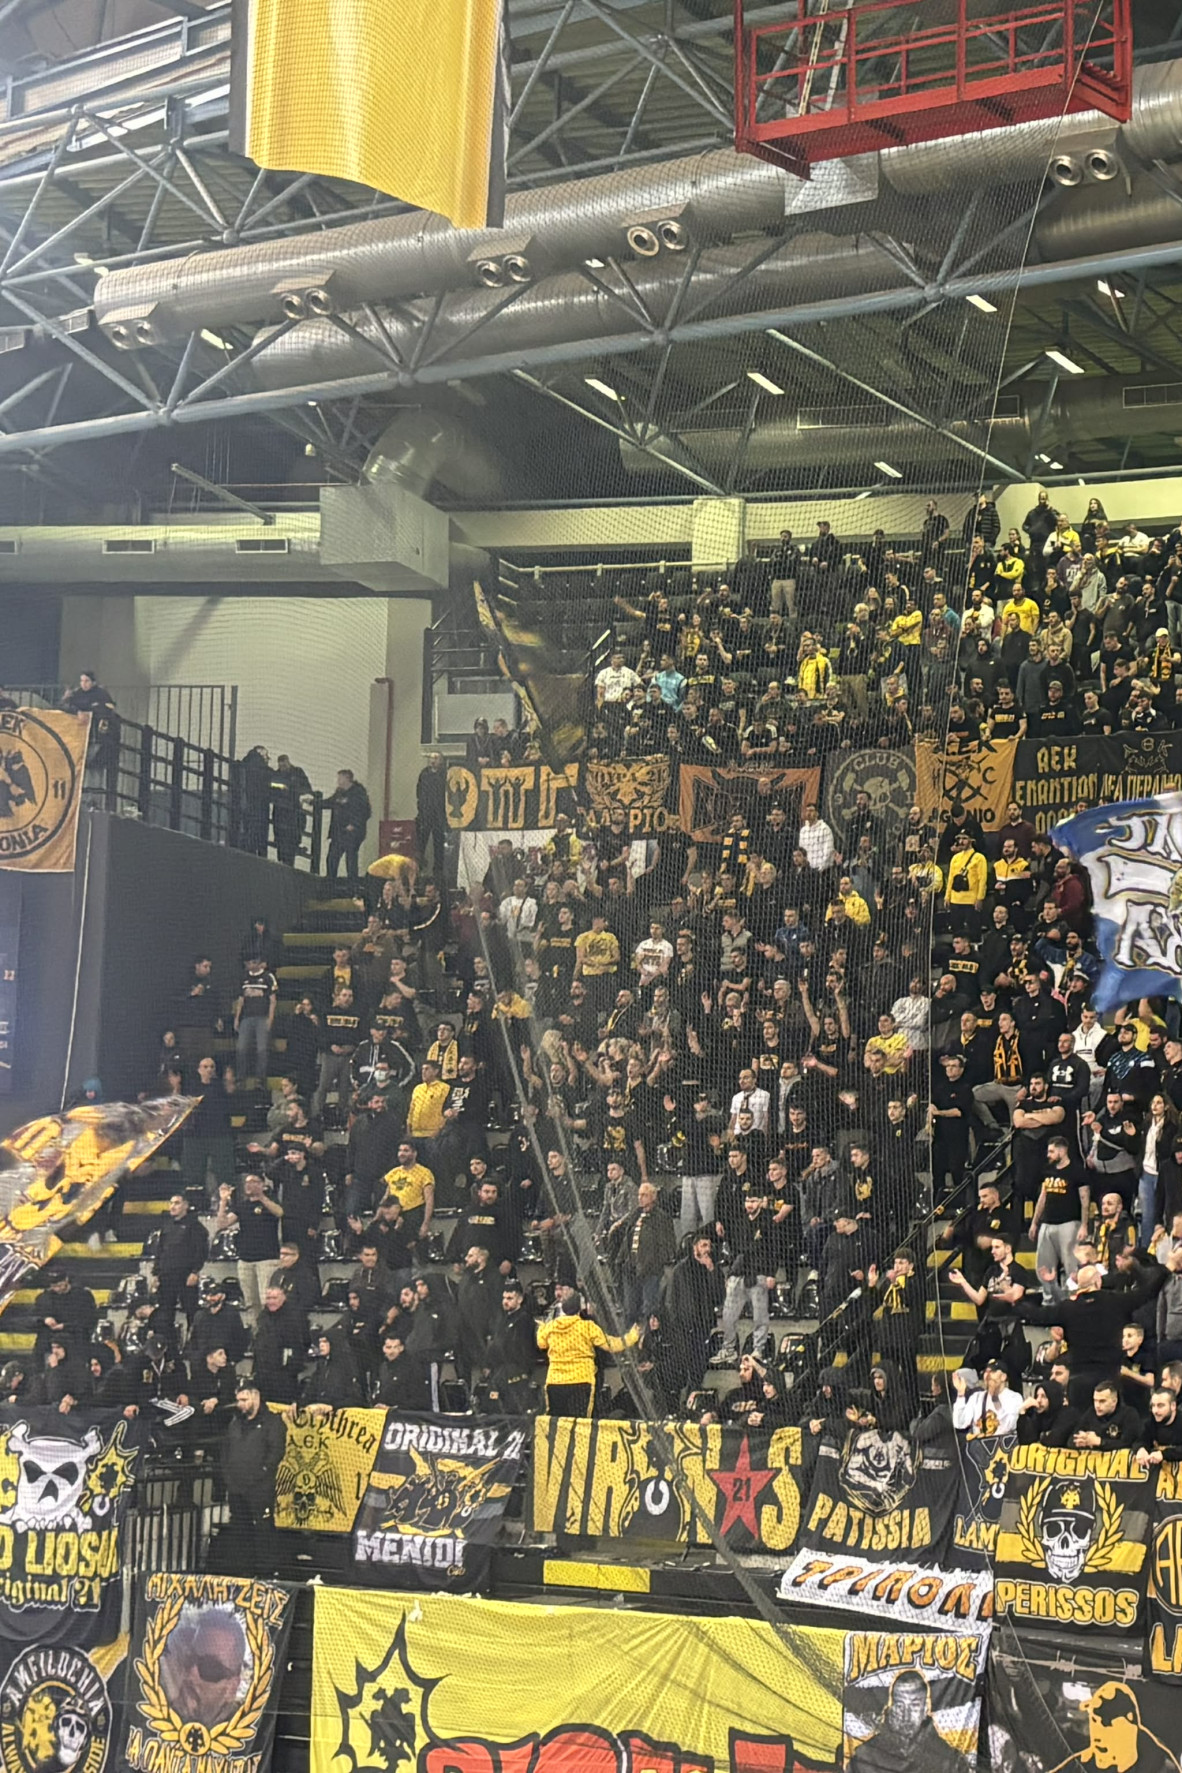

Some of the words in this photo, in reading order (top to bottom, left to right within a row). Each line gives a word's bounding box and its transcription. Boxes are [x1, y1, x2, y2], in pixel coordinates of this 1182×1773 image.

[0, 713, 24, 736] EK
[929, 807, 996, 823] AGNIO
[383, 1422, 499, 1458] ORIGINAL
[1009, 1443, 1150, 1482] ORIGINAL
[732, 1477, 750, 1499] 21
[807, 1492, 931, 1551] PATISSIA
[954, 1515, 999, 1553] LAM
[354, 1529, 468, 1568] MENIDI
[995, 1579, 1139, 1626] PERISSOS
